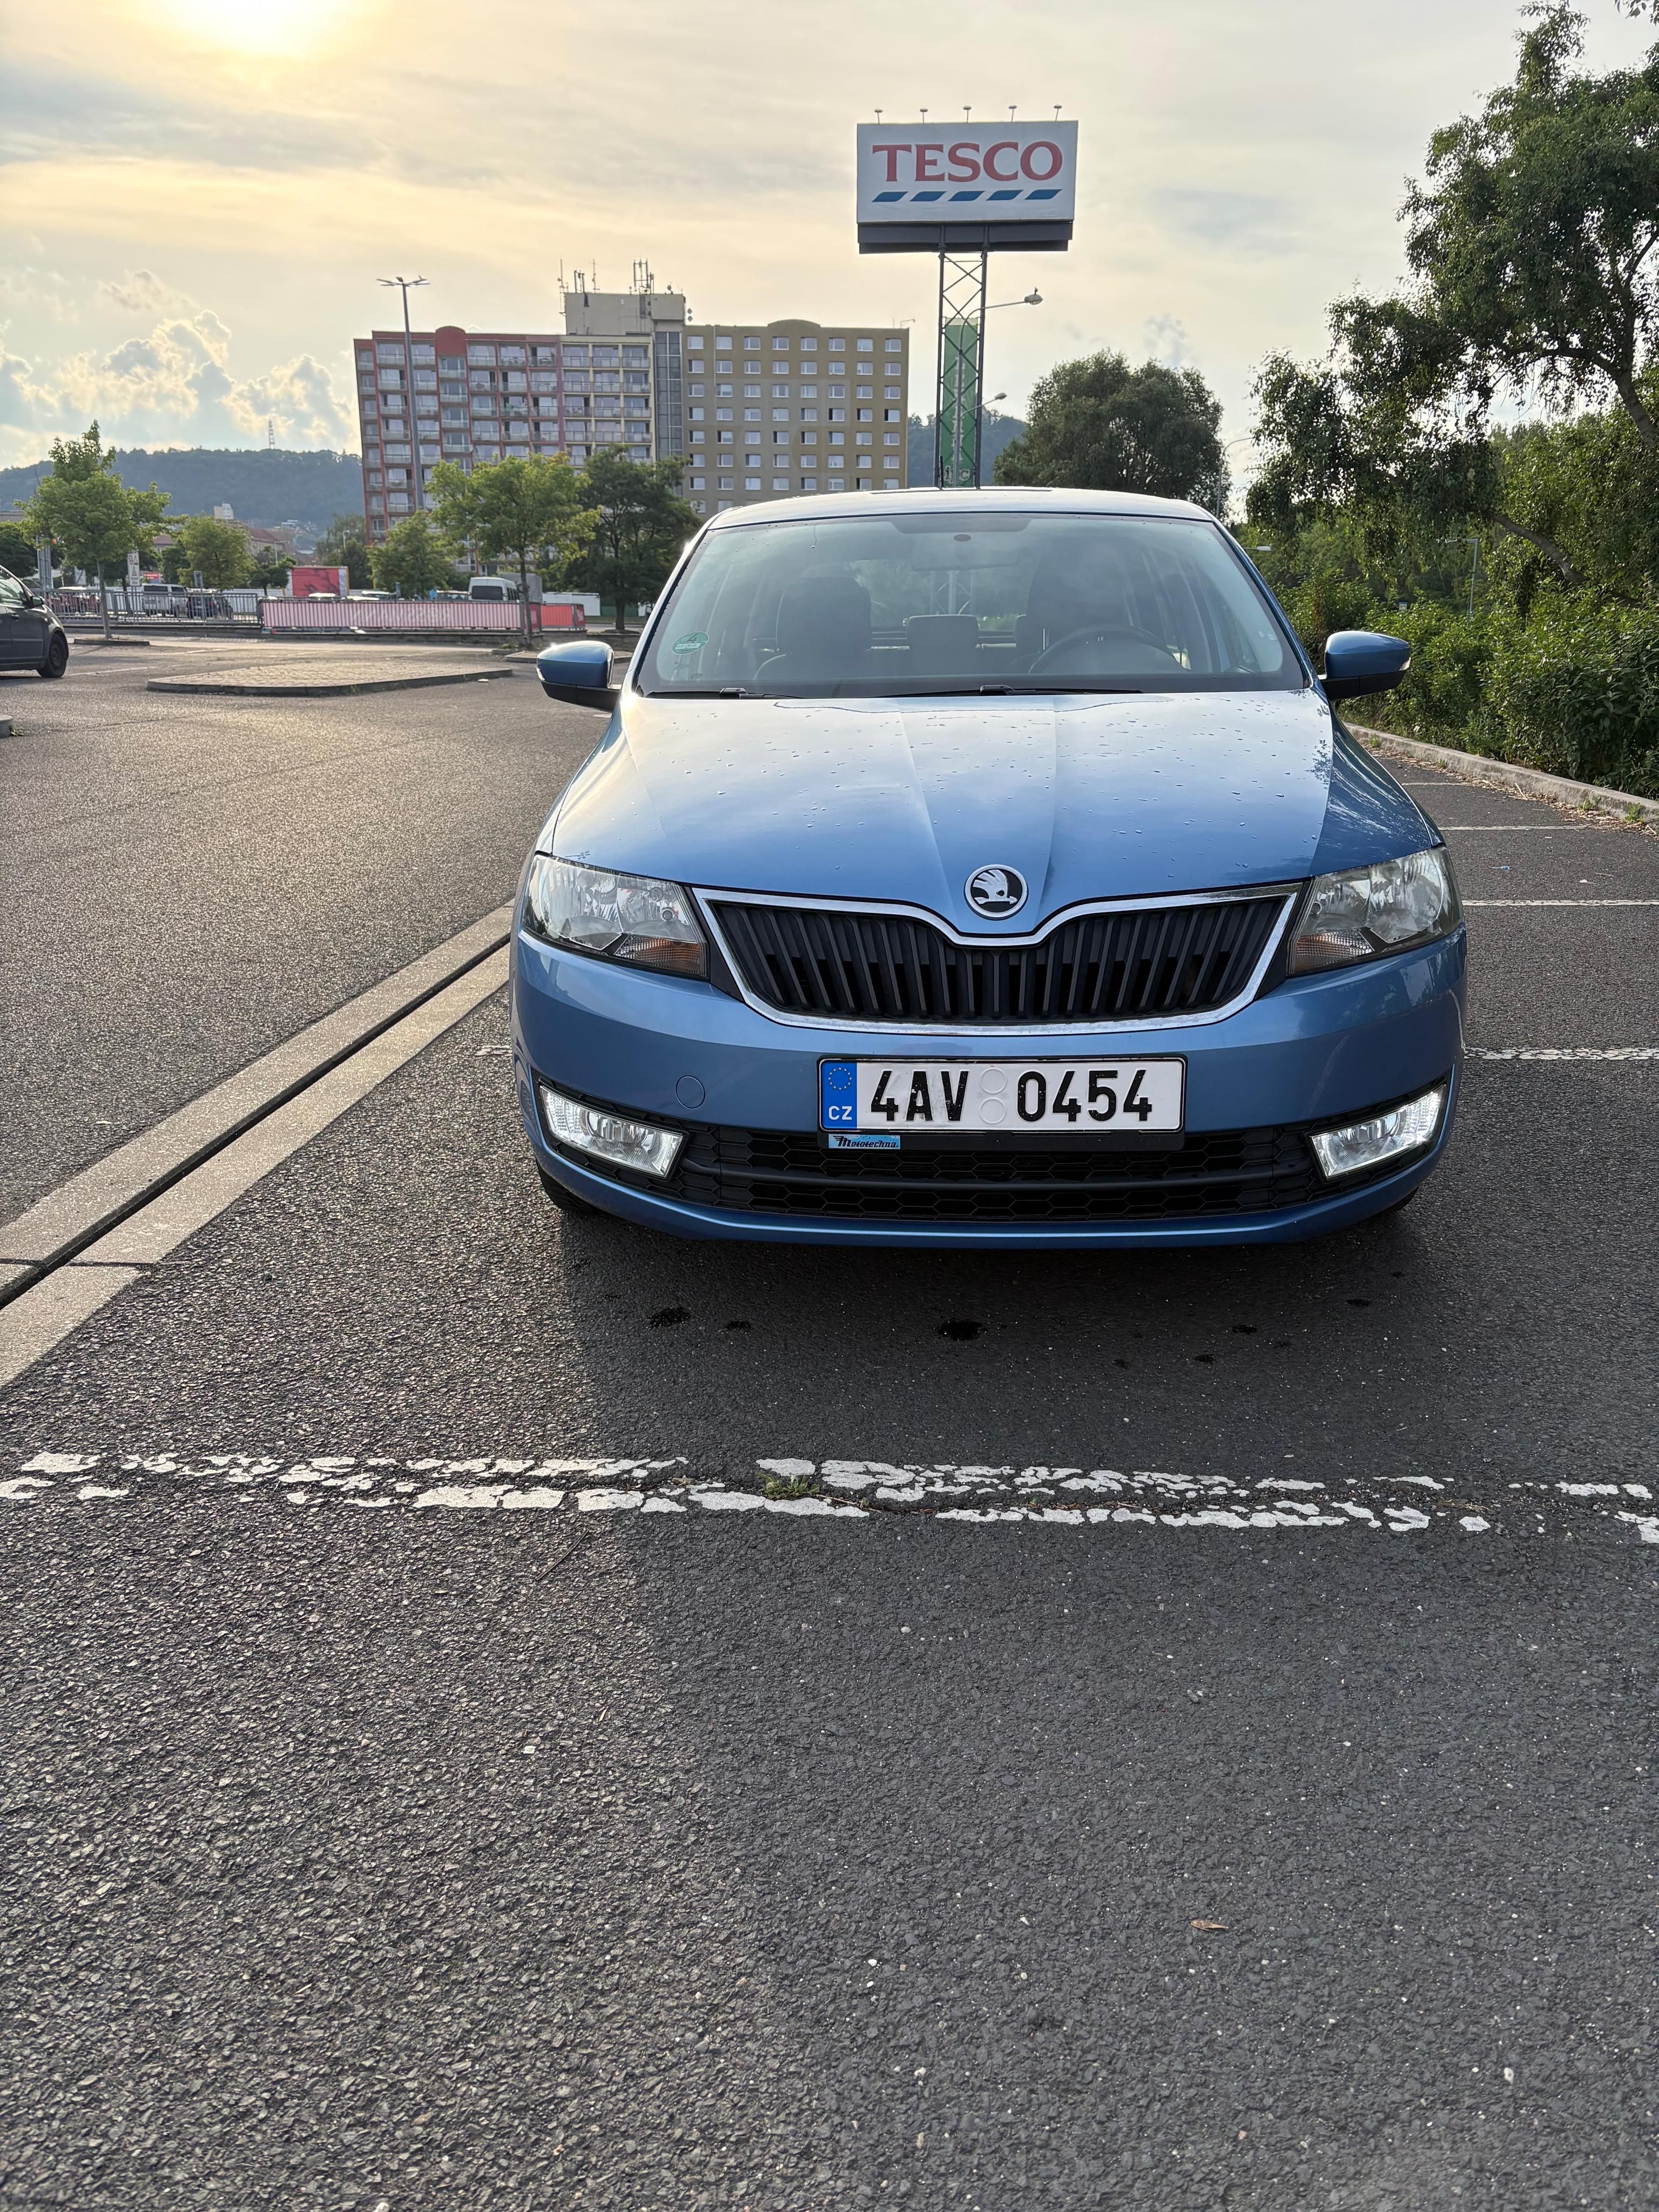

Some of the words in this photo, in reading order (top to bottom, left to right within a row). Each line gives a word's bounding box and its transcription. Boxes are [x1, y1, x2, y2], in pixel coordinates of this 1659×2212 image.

[872, 140, 1063, 183] TESCO
[871, 1070, 969, 1122] 4AV
[1017, 1069, 1152, 1122] 0454
[828, 1105, 852, 1121] CZ
[833, 1135, 896, 1148] Mototechna
